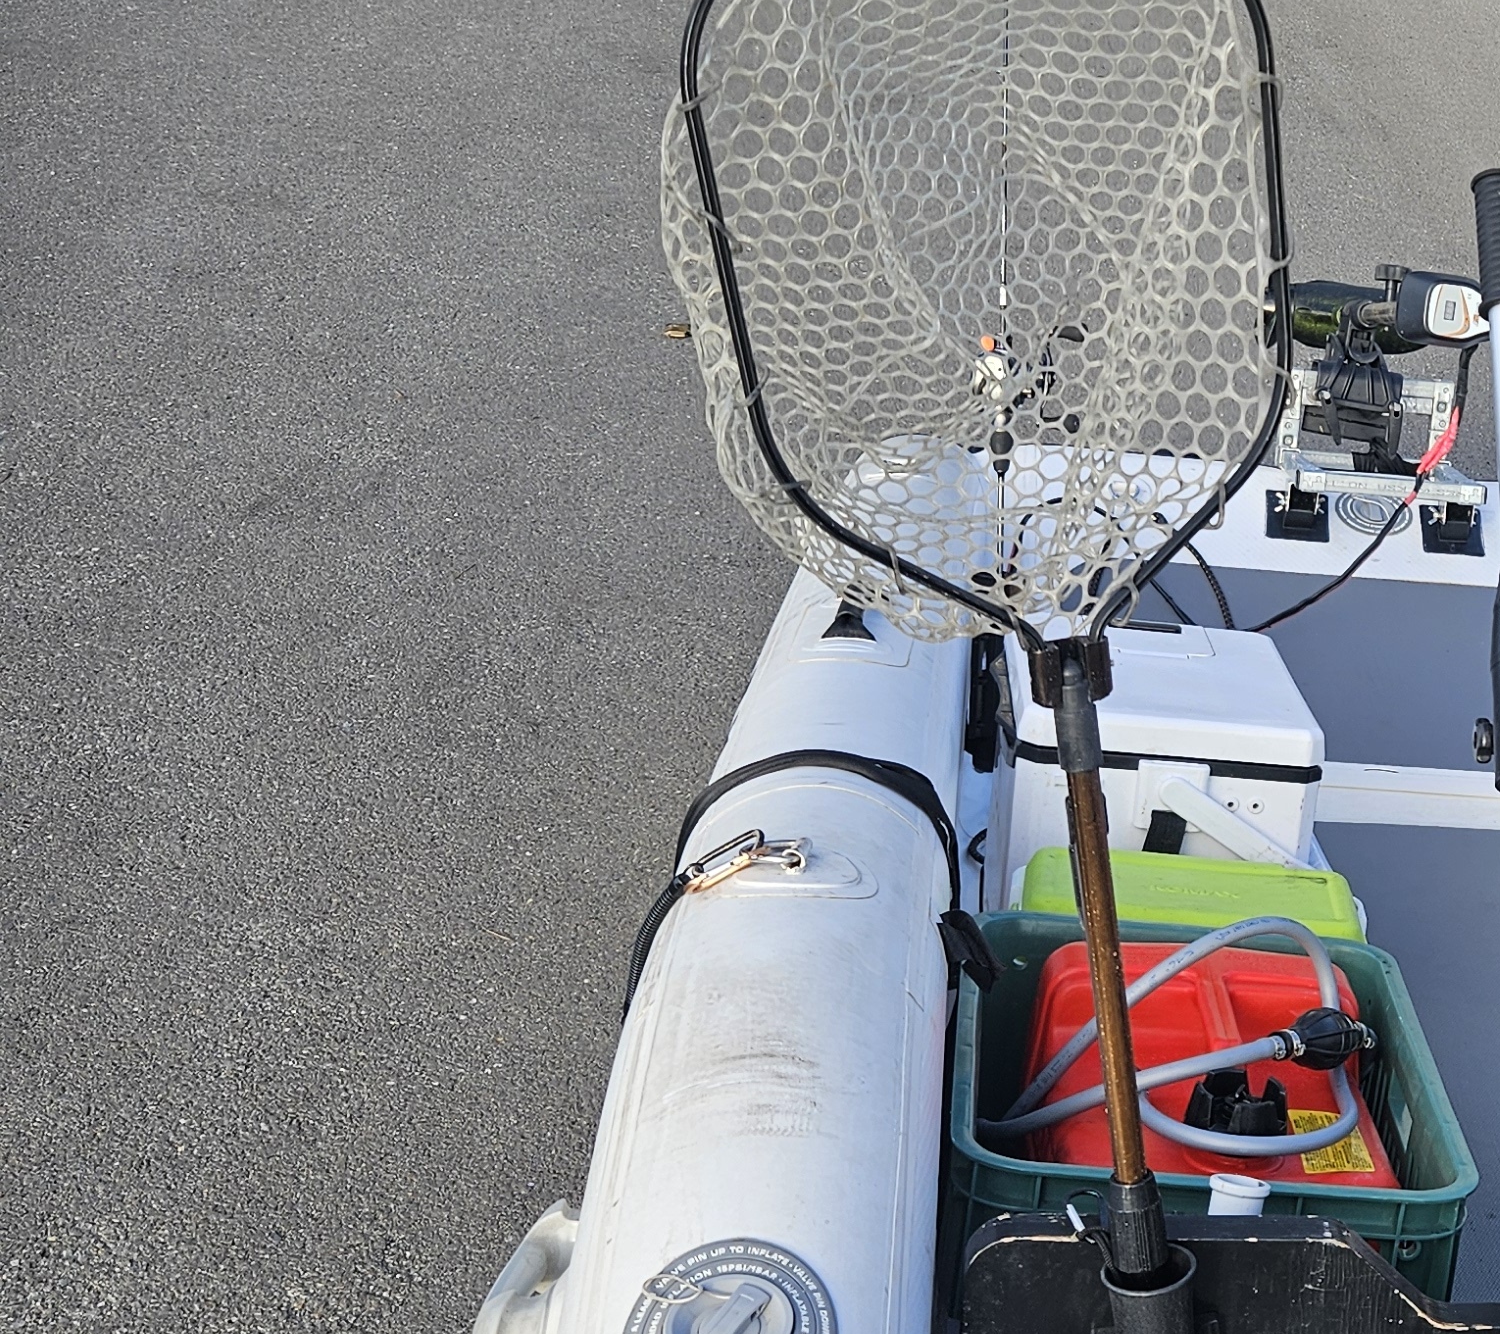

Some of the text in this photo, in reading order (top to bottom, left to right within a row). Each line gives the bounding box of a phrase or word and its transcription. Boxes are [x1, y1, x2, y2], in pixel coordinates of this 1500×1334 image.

[655, 1264, 686, 1289] VAVE
[686, 1252, 708, 1267] PIN
[710, 1247, 726, 1258] UP
[729, 1246, 744, 1254] TO
[747, 1246, 790, 1267] INFLATE
[792, 1265, 817, 1291] VALVE
